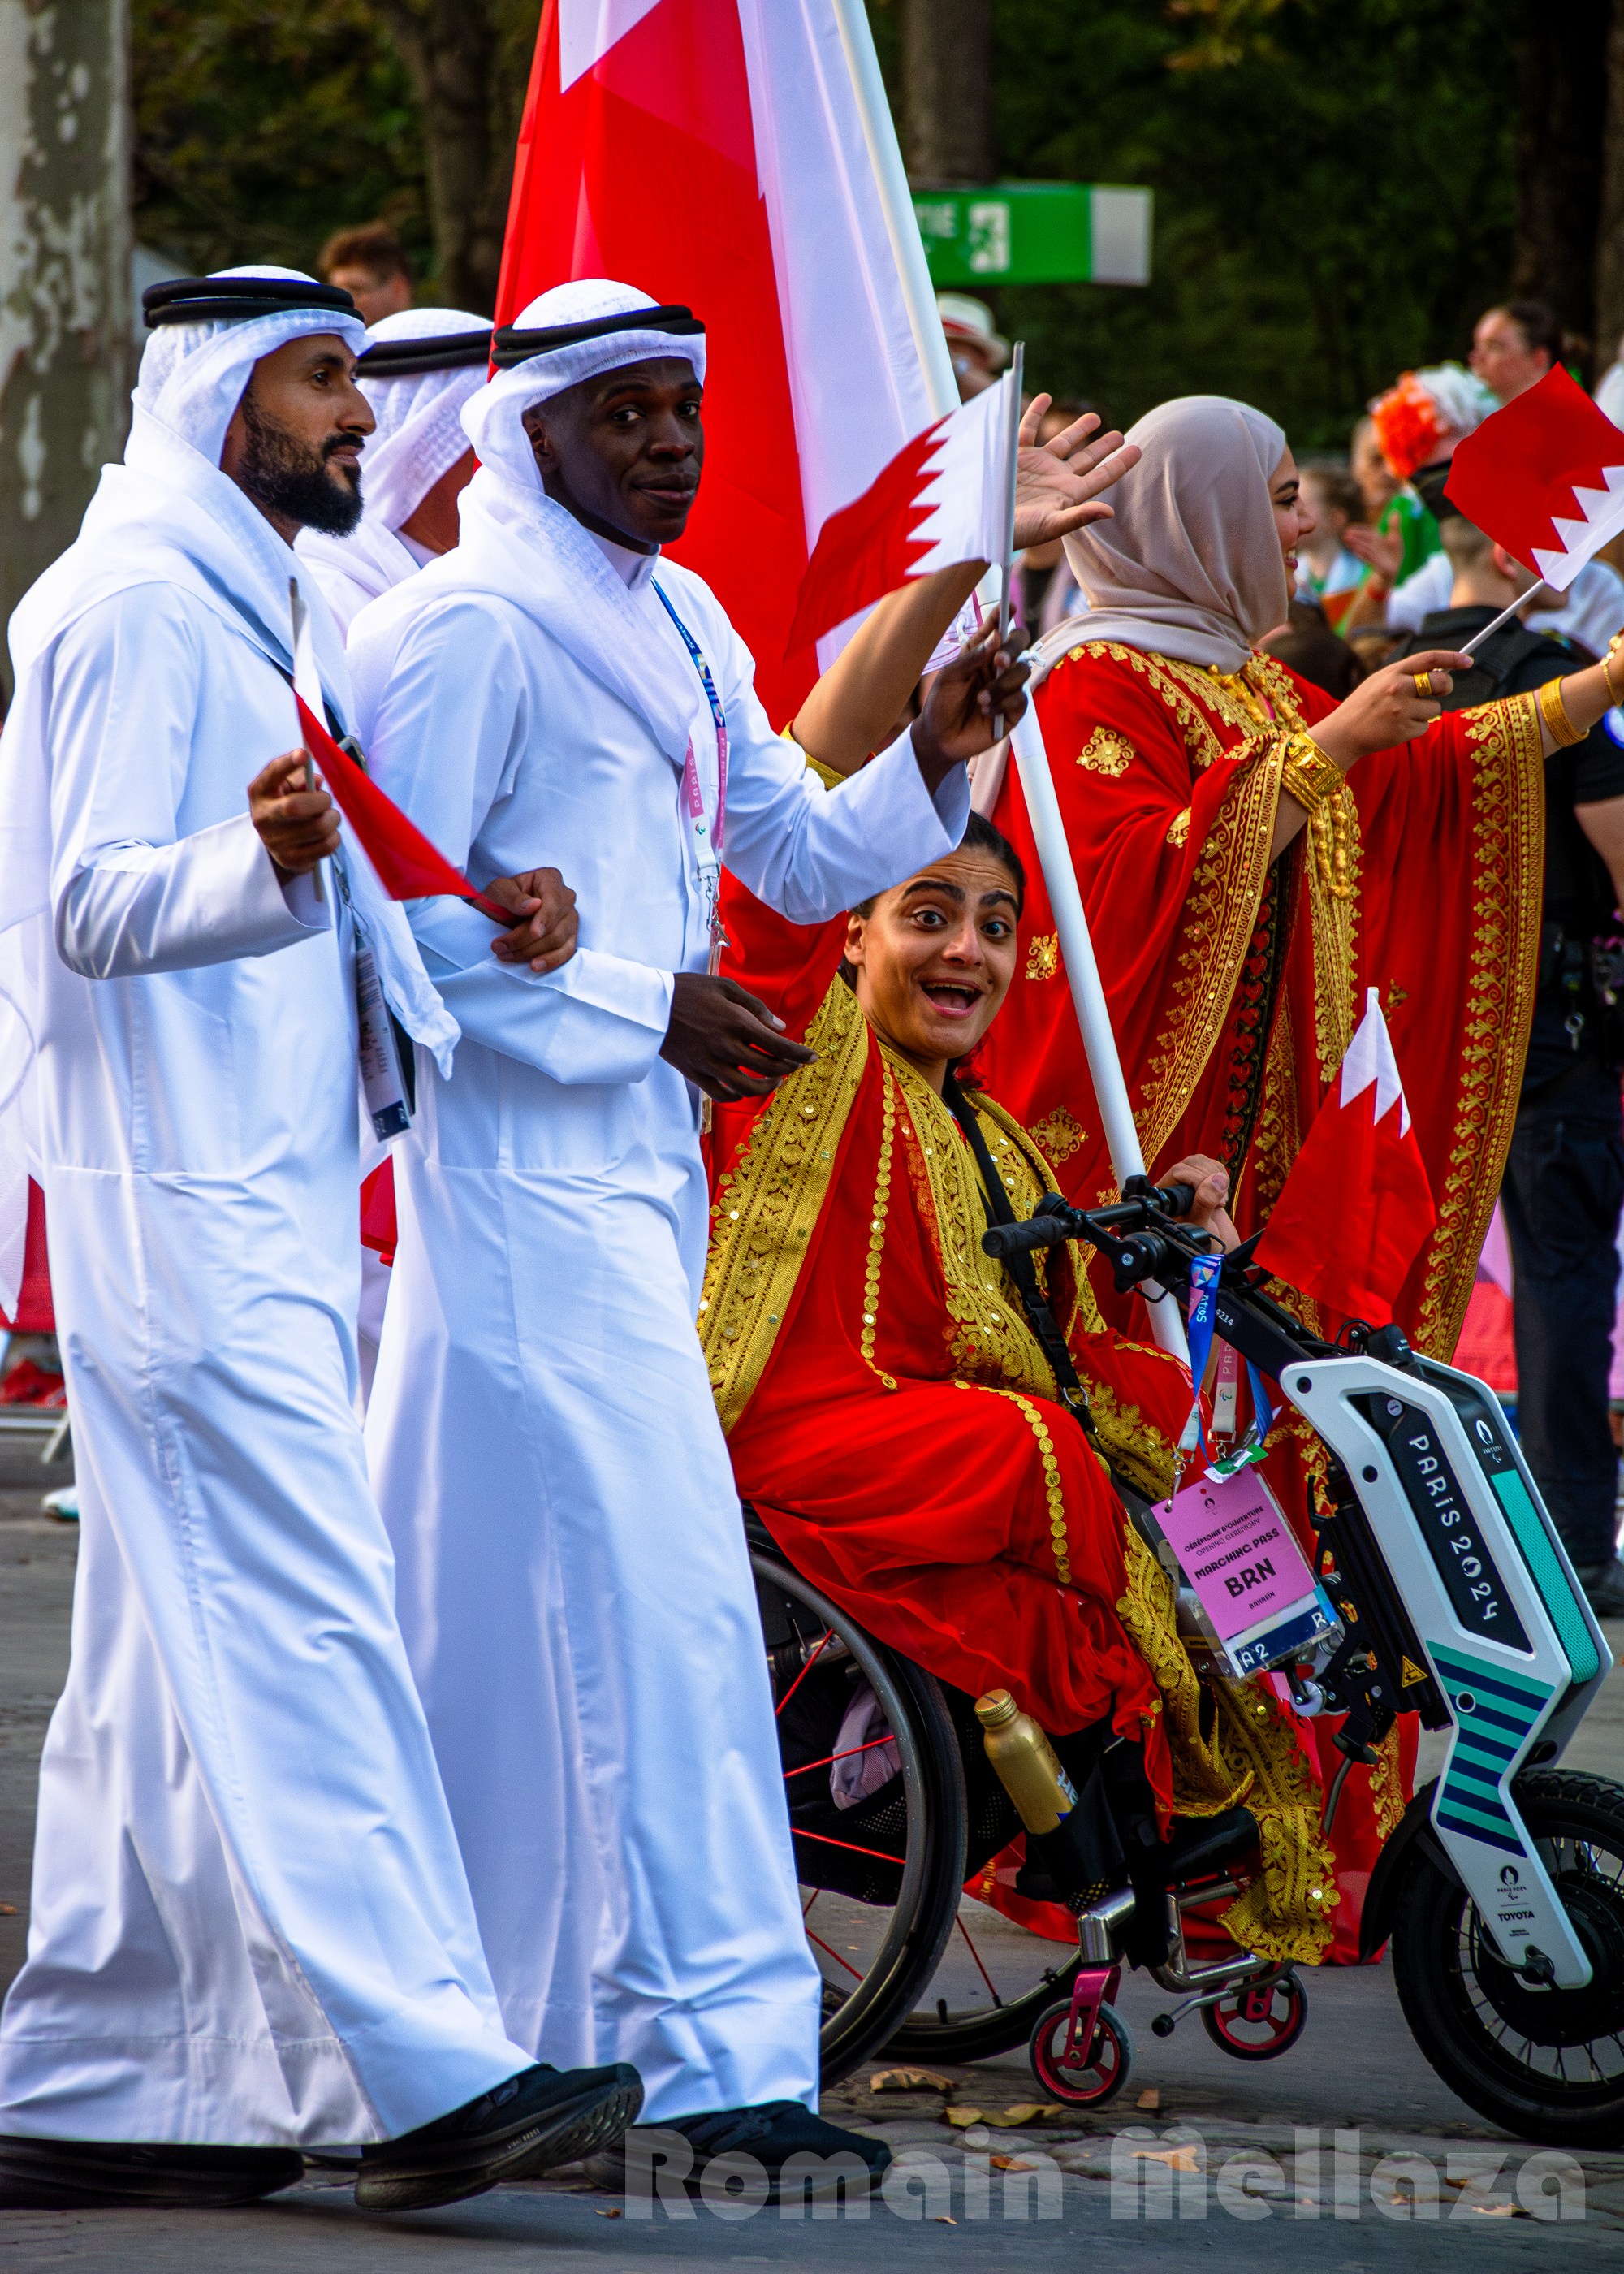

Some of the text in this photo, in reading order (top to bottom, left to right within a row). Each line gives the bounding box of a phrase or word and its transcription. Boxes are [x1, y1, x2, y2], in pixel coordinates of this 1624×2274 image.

[1215, 1308, 1234, 1327] 4214
[1184, 1528, 1222, 1552] CÉRÉMONIE
[1221, 1505, 1264, 1533] D'OUVERTURE
[1196, 1517, 1261, 1557] OPENING CEREMONY
[1194, 1528, 1281, 1580] MARCHING PASS
[1224, 1557, 1276, 1598] BRN
[1450, 1535, 1498, 1621] 2024
[1311, 1611, 1328, 1628] R
[1497, 1910, 1535, 1922] TOYOTA
